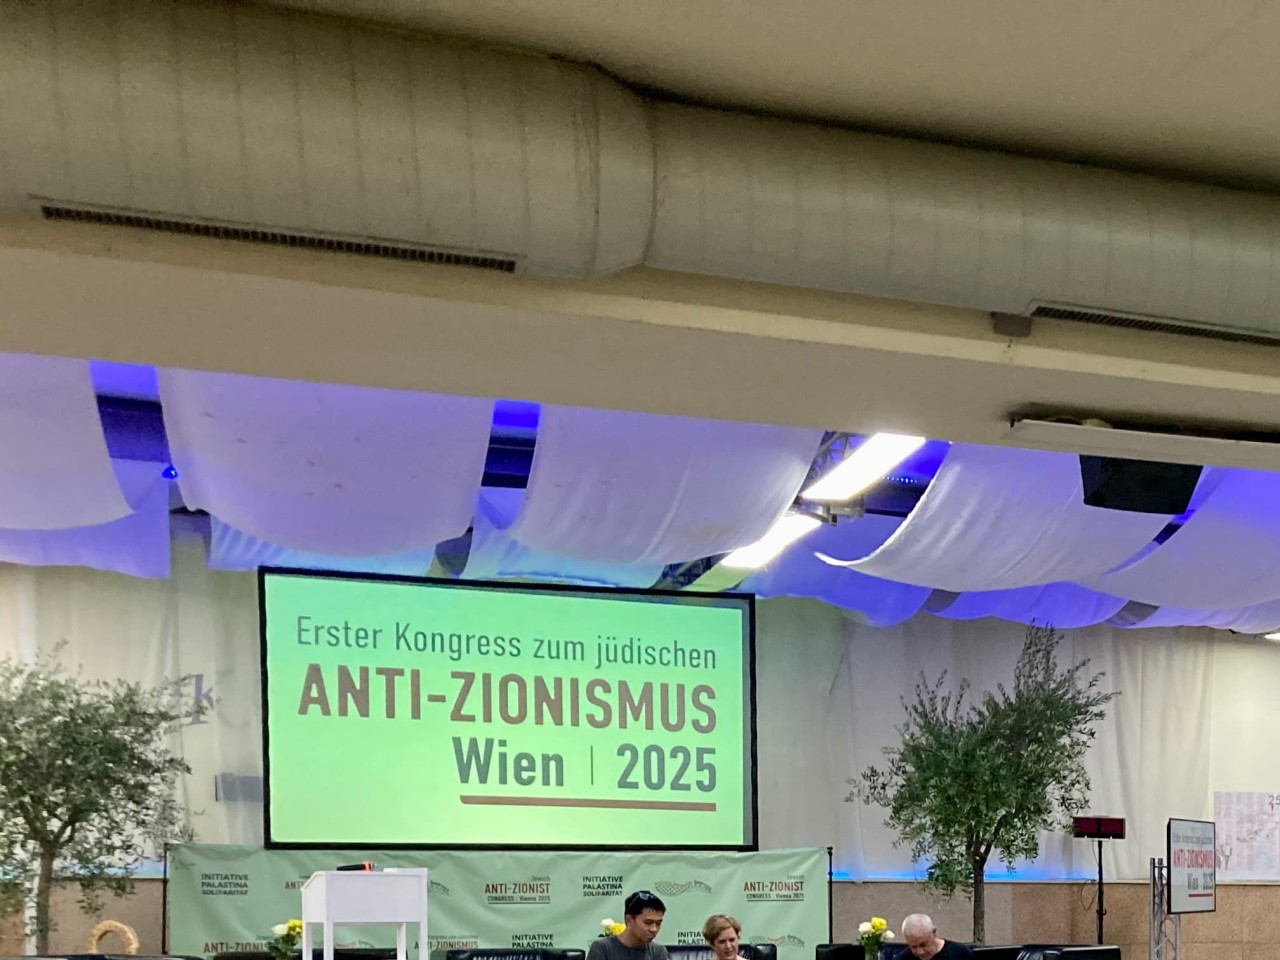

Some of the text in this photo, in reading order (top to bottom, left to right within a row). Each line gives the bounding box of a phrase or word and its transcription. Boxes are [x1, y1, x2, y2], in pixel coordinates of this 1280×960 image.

[296, 615, 717, 670] Erster Kongress zum jüdischen
[297, 662, 718, 734] ANTI-ZIONISMUS
[452, 736, 717, 793] Wien 2025
[201, 873, 248, 881] INITIATIVE
[484, 883, 551, 894] ANTI-ZIONIST
[744, 881, 805, 892] ANTI-ZIONIST
[512, 933, 554, 941] INITIATIVE
